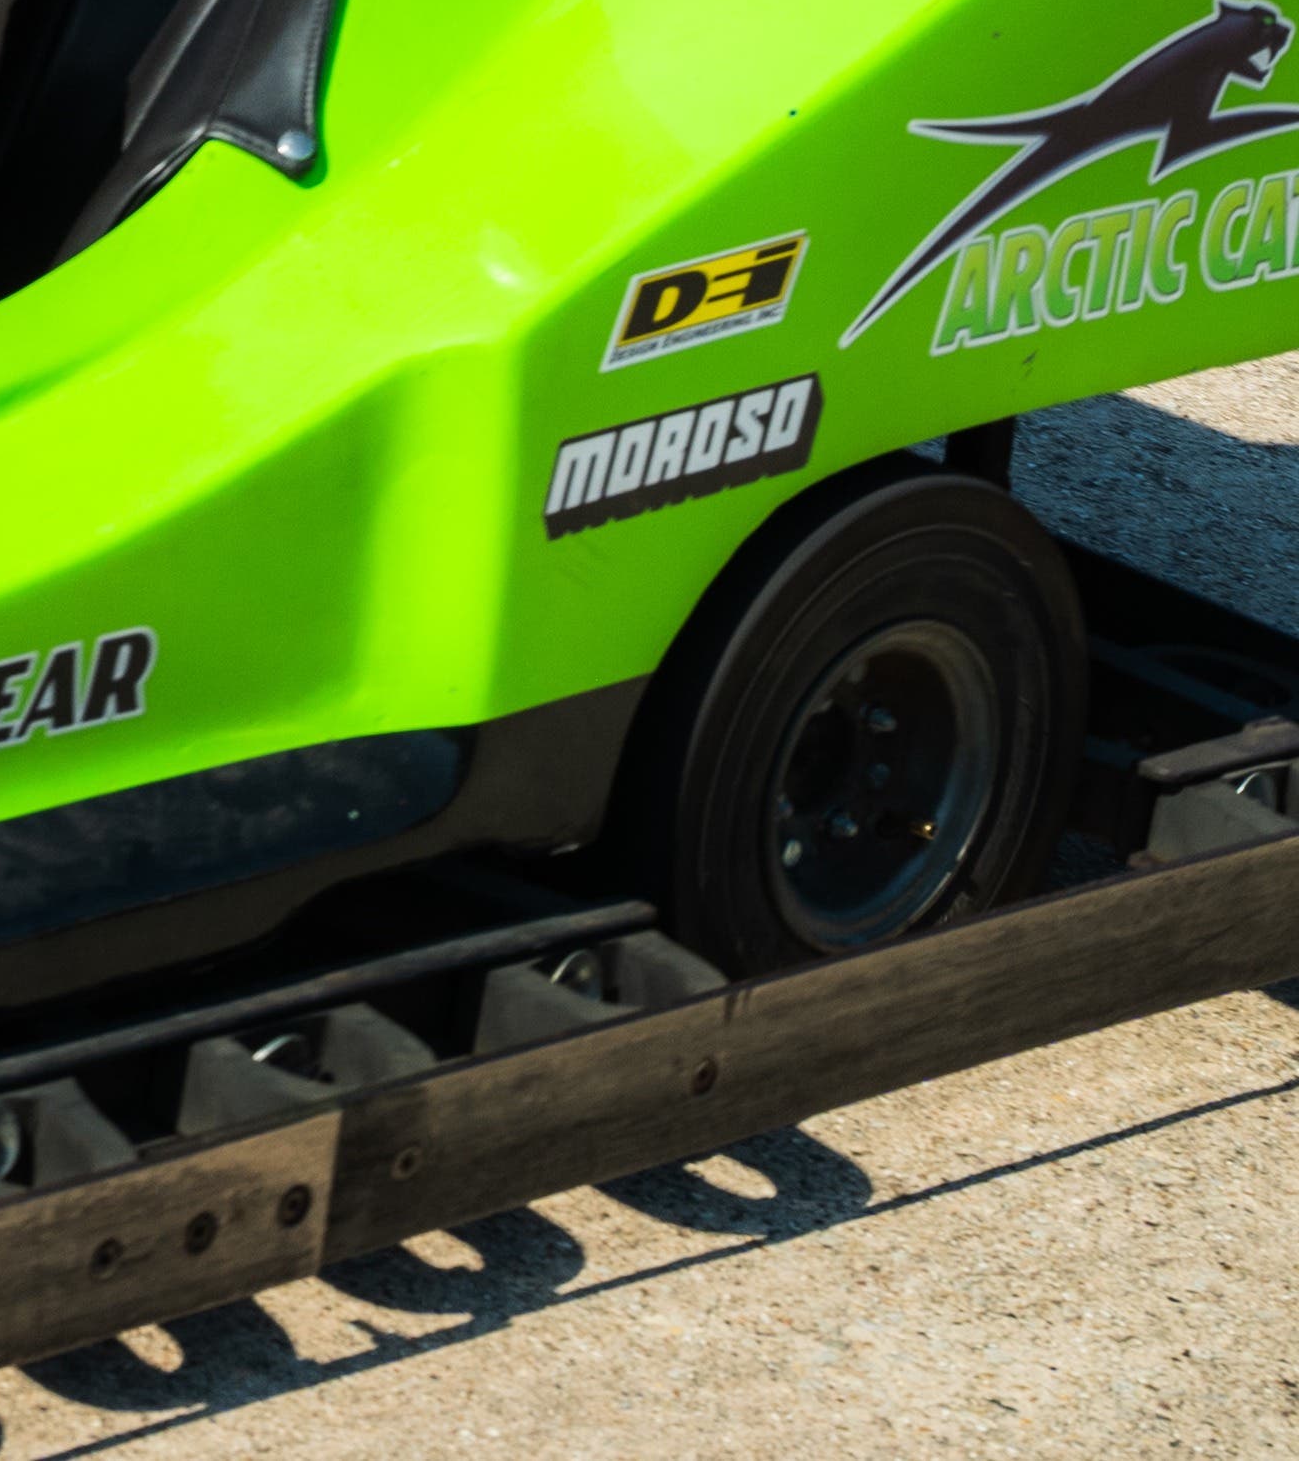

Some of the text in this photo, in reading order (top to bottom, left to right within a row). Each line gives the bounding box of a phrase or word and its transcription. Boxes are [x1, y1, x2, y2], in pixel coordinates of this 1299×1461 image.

[932, 168, 1299, 354] ARCTIC CA
[544, 374, 818, 521] MOROSO
